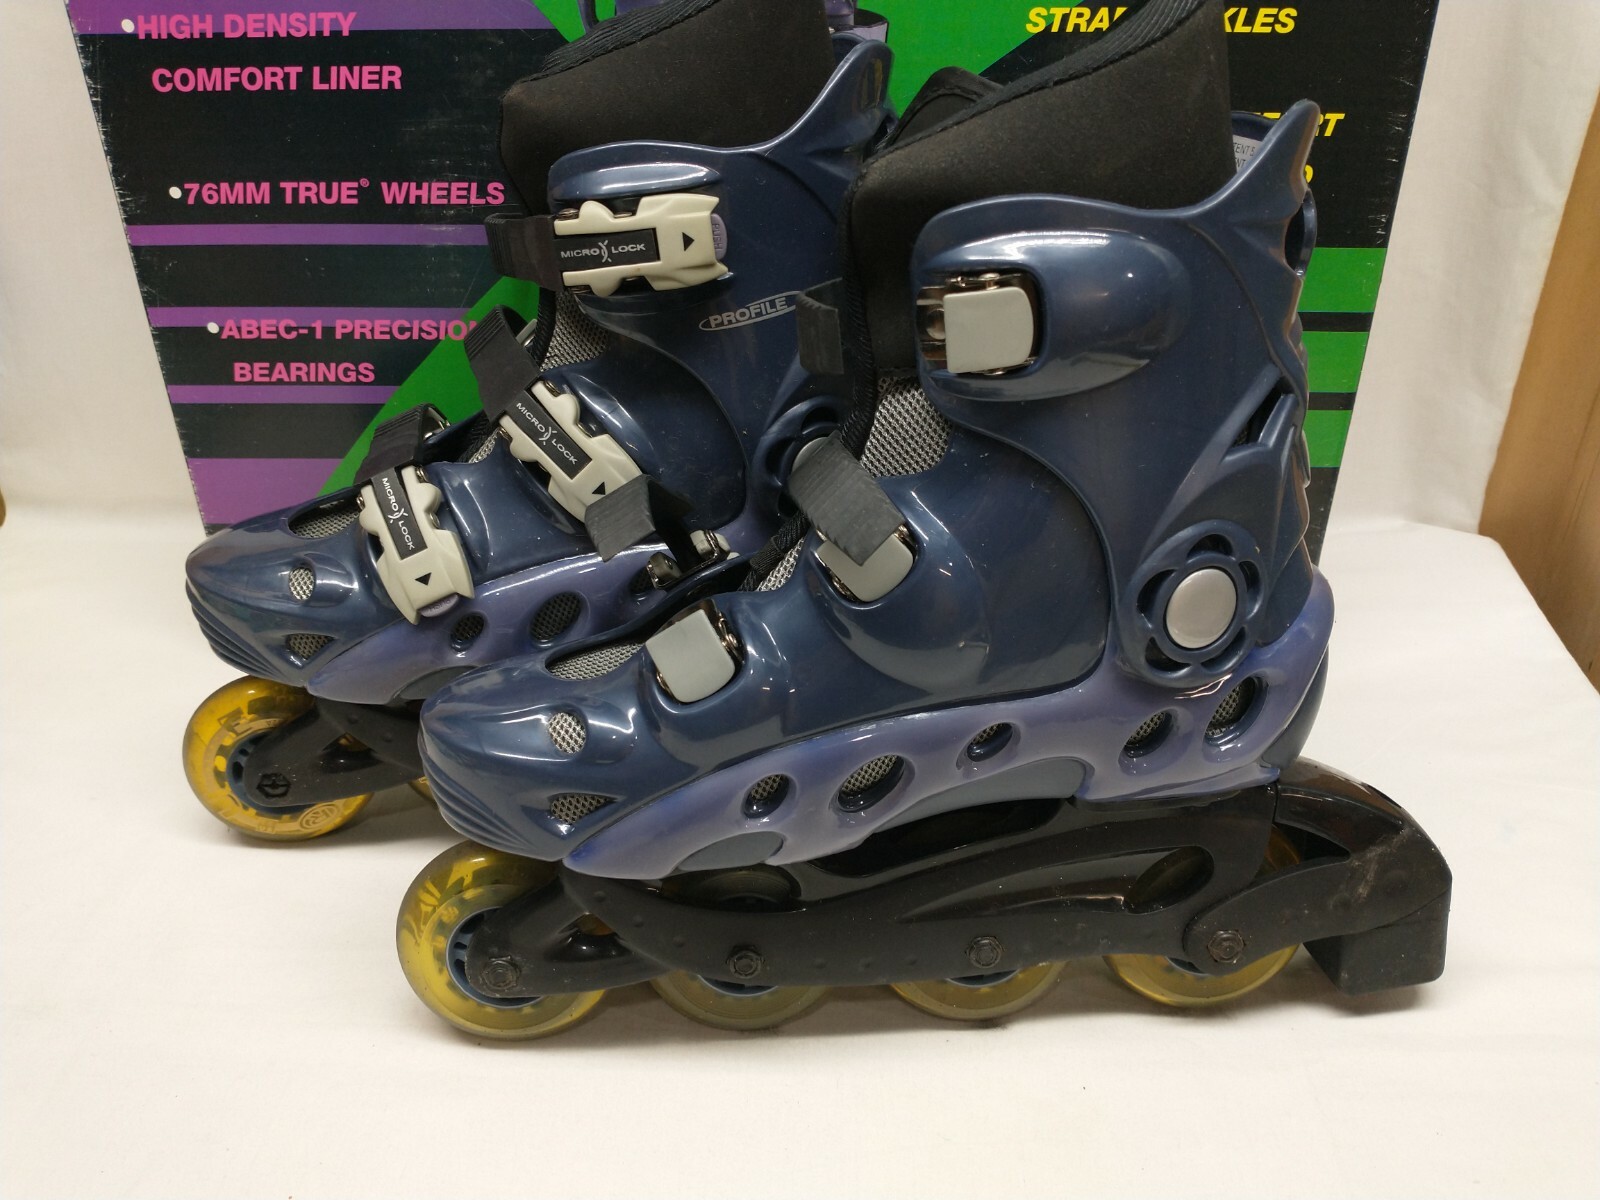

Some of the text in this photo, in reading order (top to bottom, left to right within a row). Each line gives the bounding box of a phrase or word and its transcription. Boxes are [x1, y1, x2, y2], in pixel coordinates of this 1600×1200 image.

[136, 11, 357, 40] HIGH DENSITY
[1025, 7, 1298, 34] STRA KLES
[152, 65, 402, 93] COMFORT LINER
[184, 182, 270, 205] 76MM
[381, 182, 505, 205] WHEELS
[560, 243, 646, 258] MICRO LOCK
[709, 297, 788, 328] PROFILE
[221, 318, 323, 340] ABEC-1
[234, 361, 375, 383] BEARINGS
[516, 402, 578, 465] MICRO LOCK
[382, 477, 415, 550] MICRO LOCK
